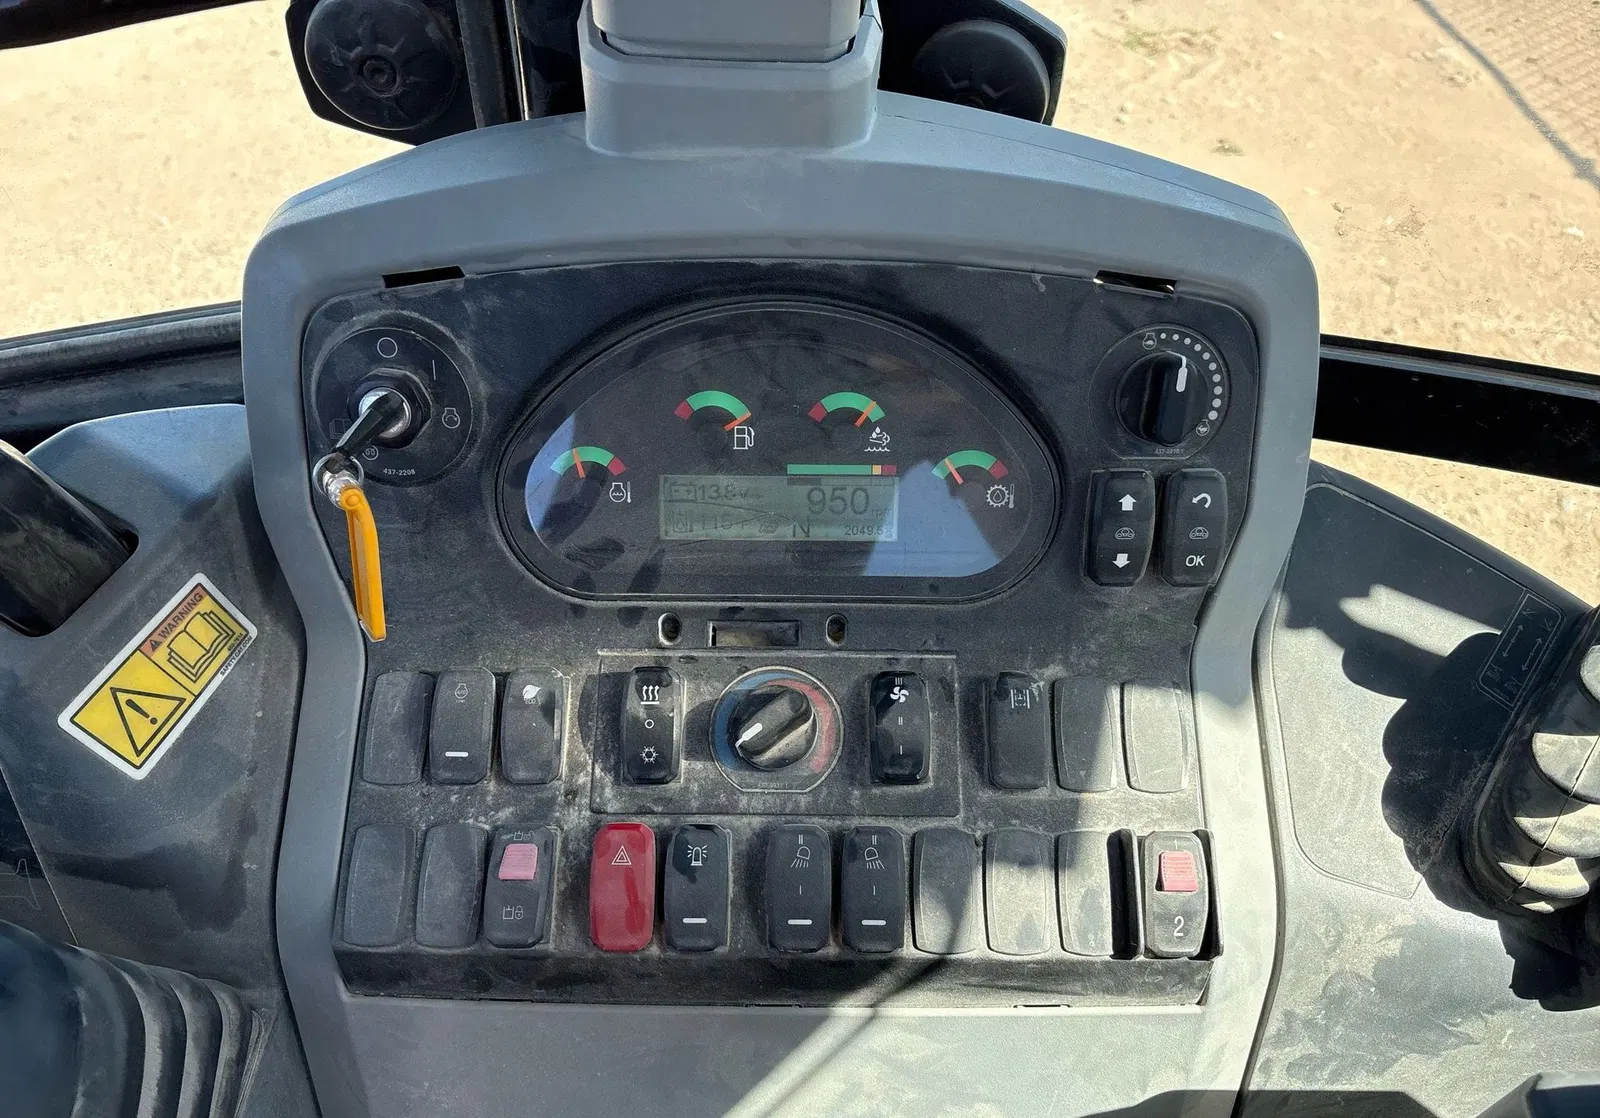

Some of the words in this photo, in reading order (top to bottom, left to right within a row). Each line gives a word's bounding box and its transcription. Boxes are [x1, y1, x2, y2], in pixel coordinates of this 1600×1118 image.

[382, 467, 416, 476] 437-2208
[806, 487, 871, 515] 950
[792, 515, 811, 538] N
[844, 525, 884, 536] 2049.5
[1185, 554, 1206, 567] OK
[158, 592, 204, 641] WARNING
[1173, 915, 1186, 937] 2
